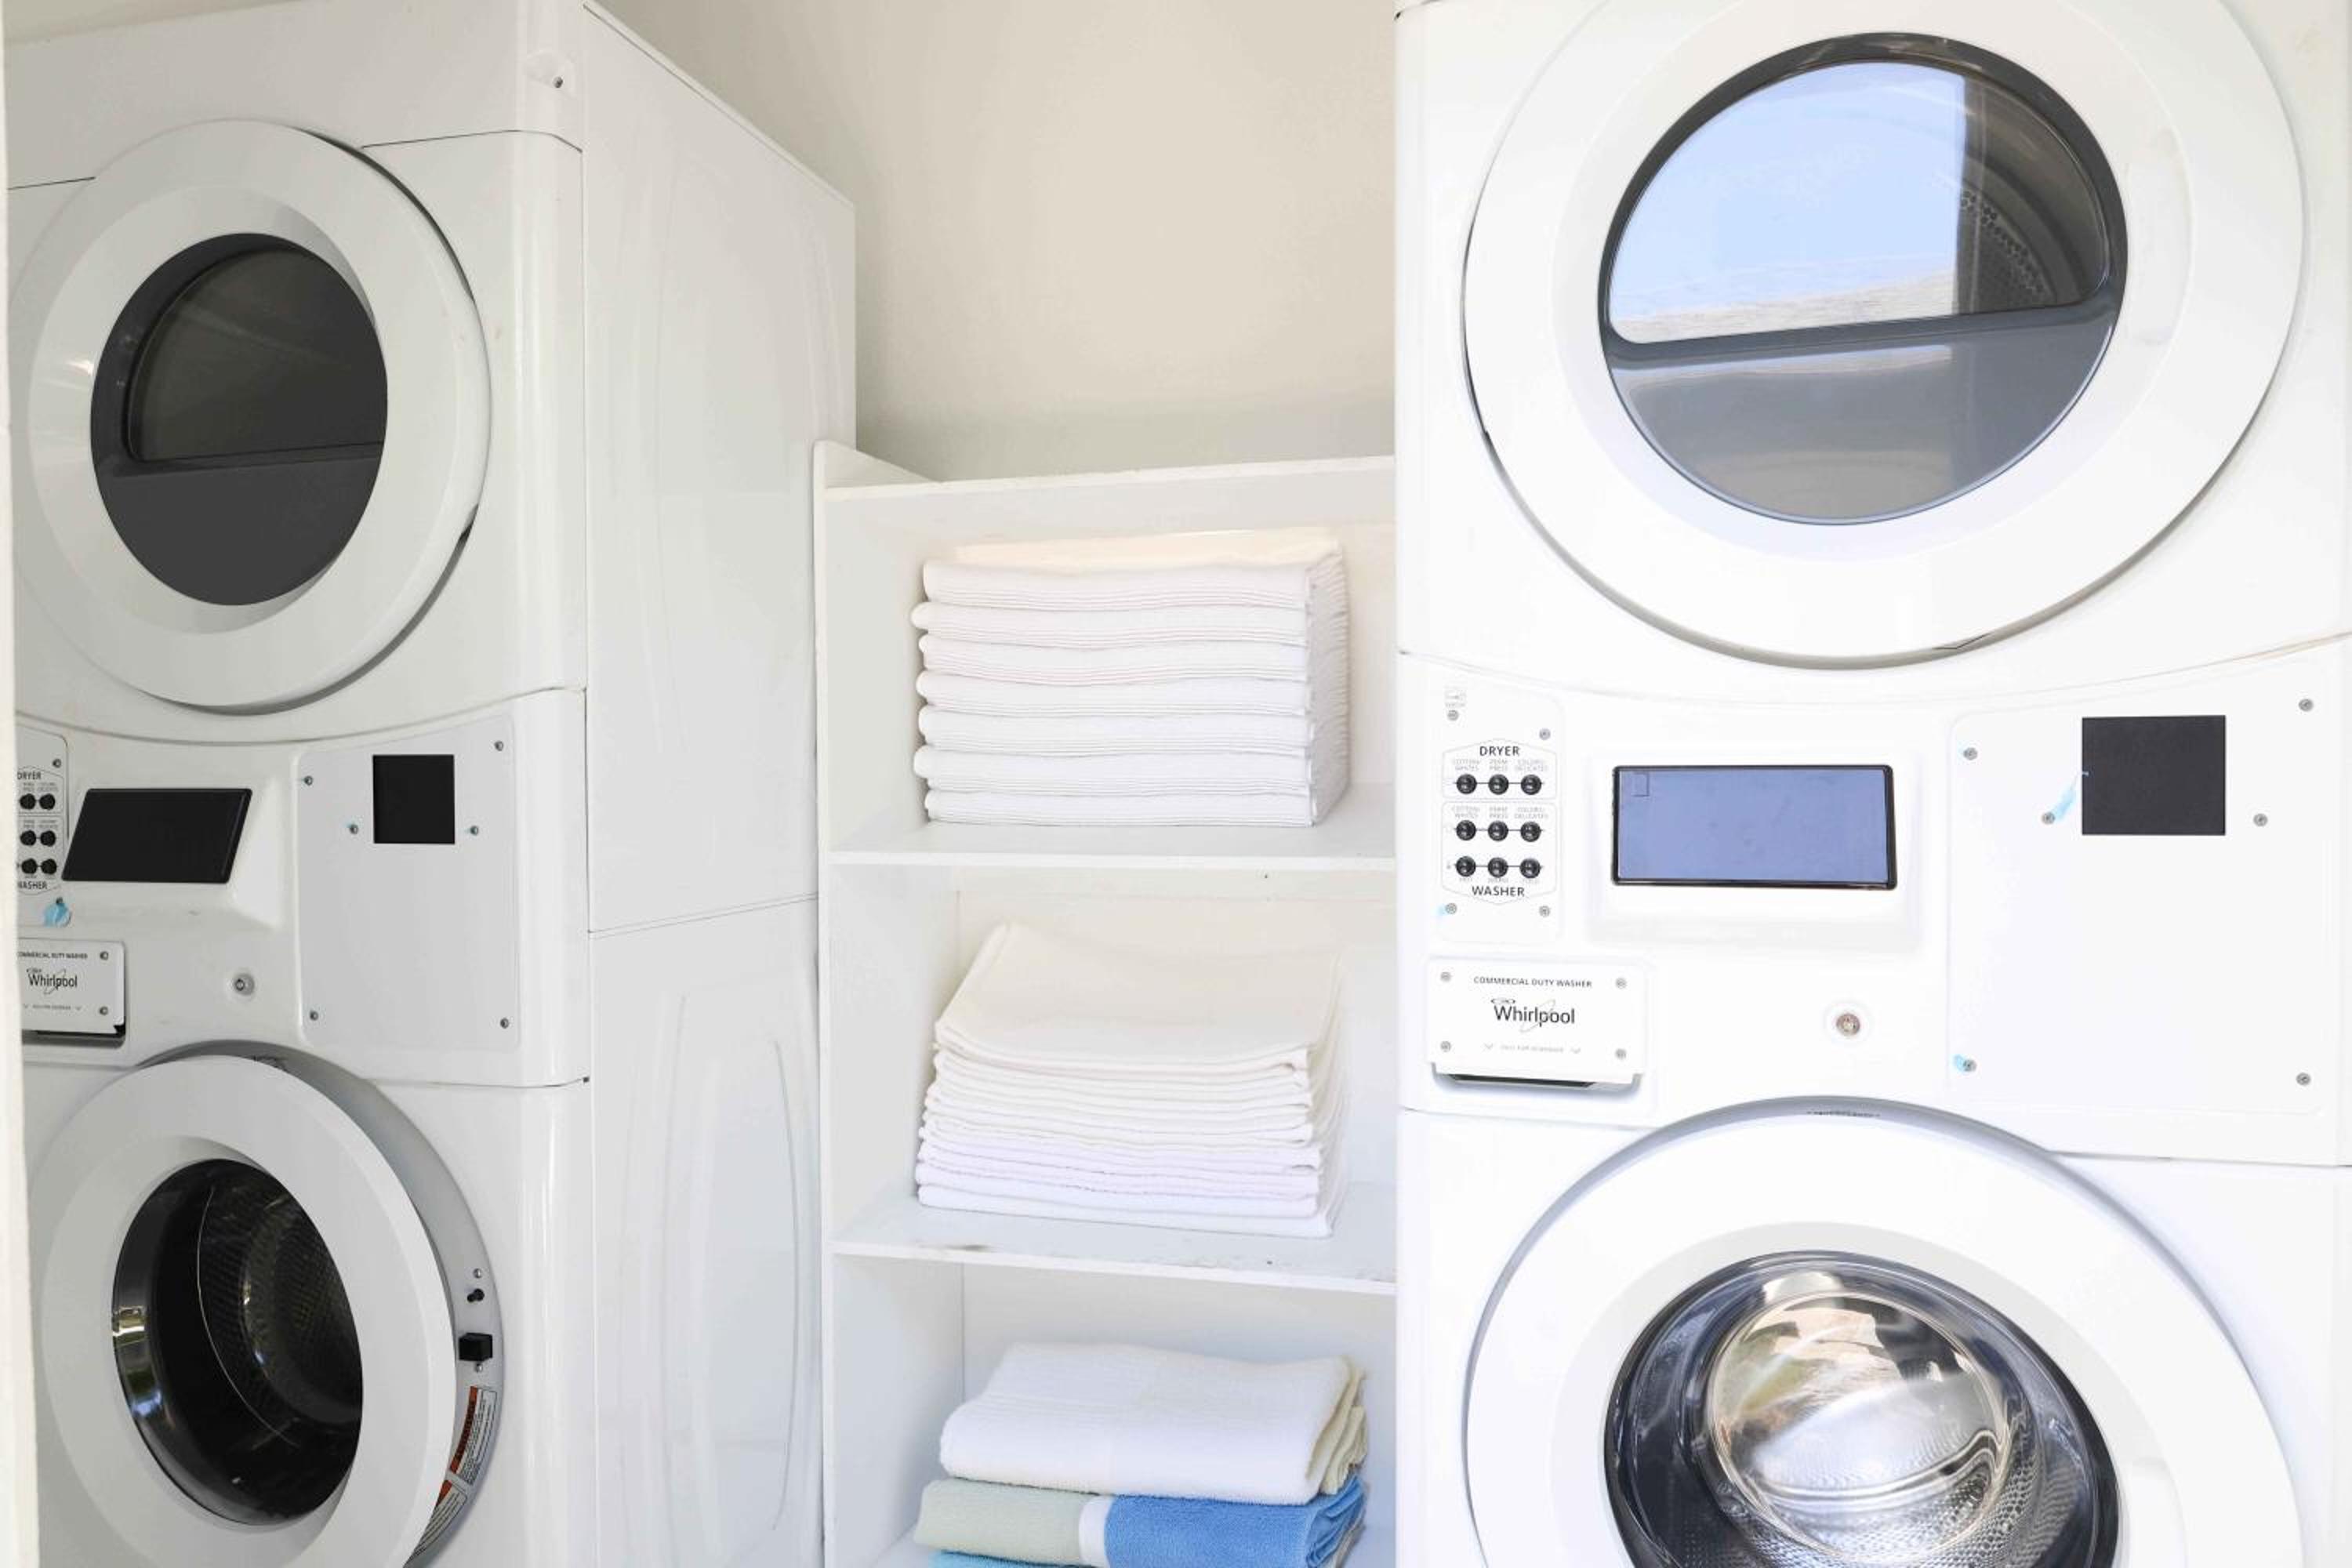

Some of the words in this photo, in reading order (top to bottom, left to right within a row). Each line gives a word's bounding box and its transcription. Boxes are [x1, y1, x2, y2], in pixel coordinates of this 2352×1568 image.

[1479, 746, 1520, 757] DRYER
[1471, 885, 1525, 897] WASHER
[27, 973, 78, 989] Whirlpool
[1473, 976, 1529, 985] COMMERCIAL
[1555, 979, 1593, 988] WASHER
[1494, 1004, 1576, 1028] Whirlpool
